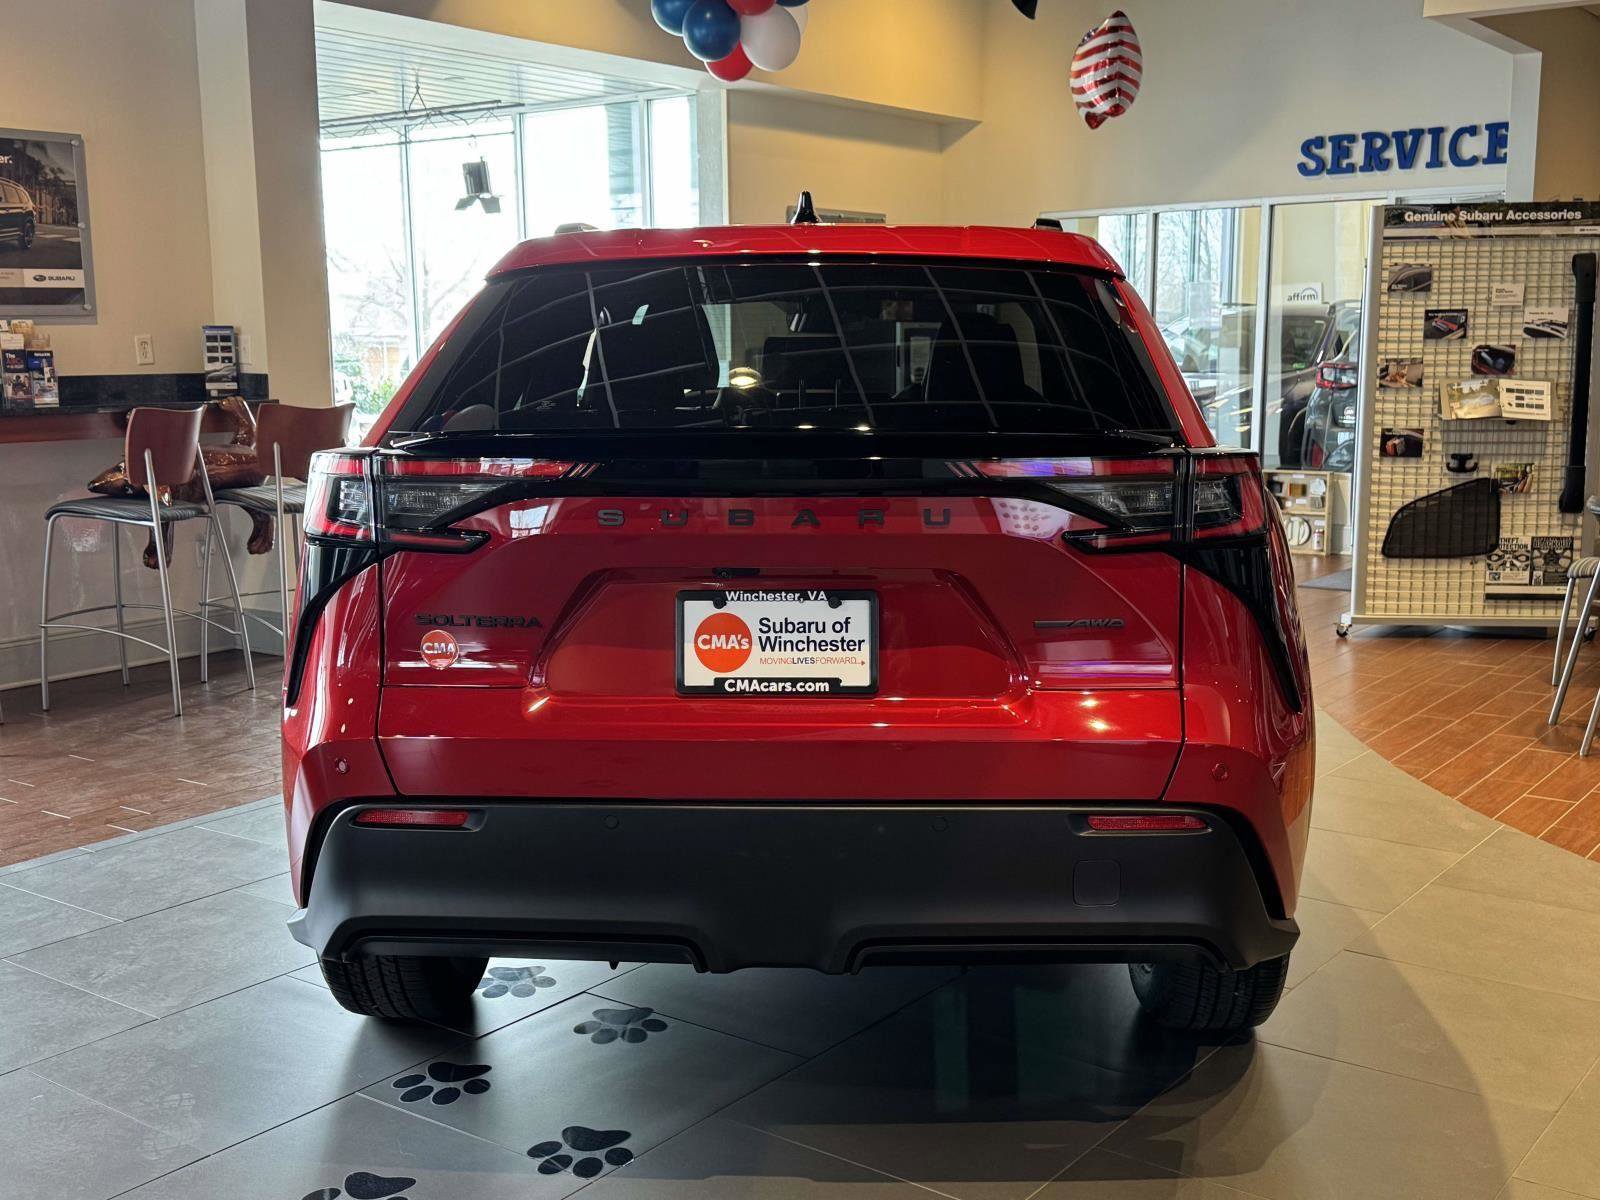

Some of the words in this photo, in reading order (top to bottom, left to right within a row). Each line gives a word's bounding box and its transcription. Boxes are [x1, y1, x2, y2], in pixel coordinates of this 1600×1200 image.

[1297, 121, 1510, 177] SERVICE
[1404, 211, 1456, 222] Genuine
[1458, 210, 1503, 222] Subaru
[1506, 209, 1582, 220] Accessories
[1287, 291, 1316, 302] affirm
[597, 508, 951, 530] SUBARU
[726, 591, 804, 603] Winchester,
[808, 591, 828, 601] VA
[416, 614, 542, 628] SOLTERRA
[758, 617, 827, 634] Subaru
[832, 617, 851, 634] of
[697, 634, 750, 650] CMA's
[758, 636, 866, 652] Winchester
[724, 679, 830, 692] CMAcars.com
